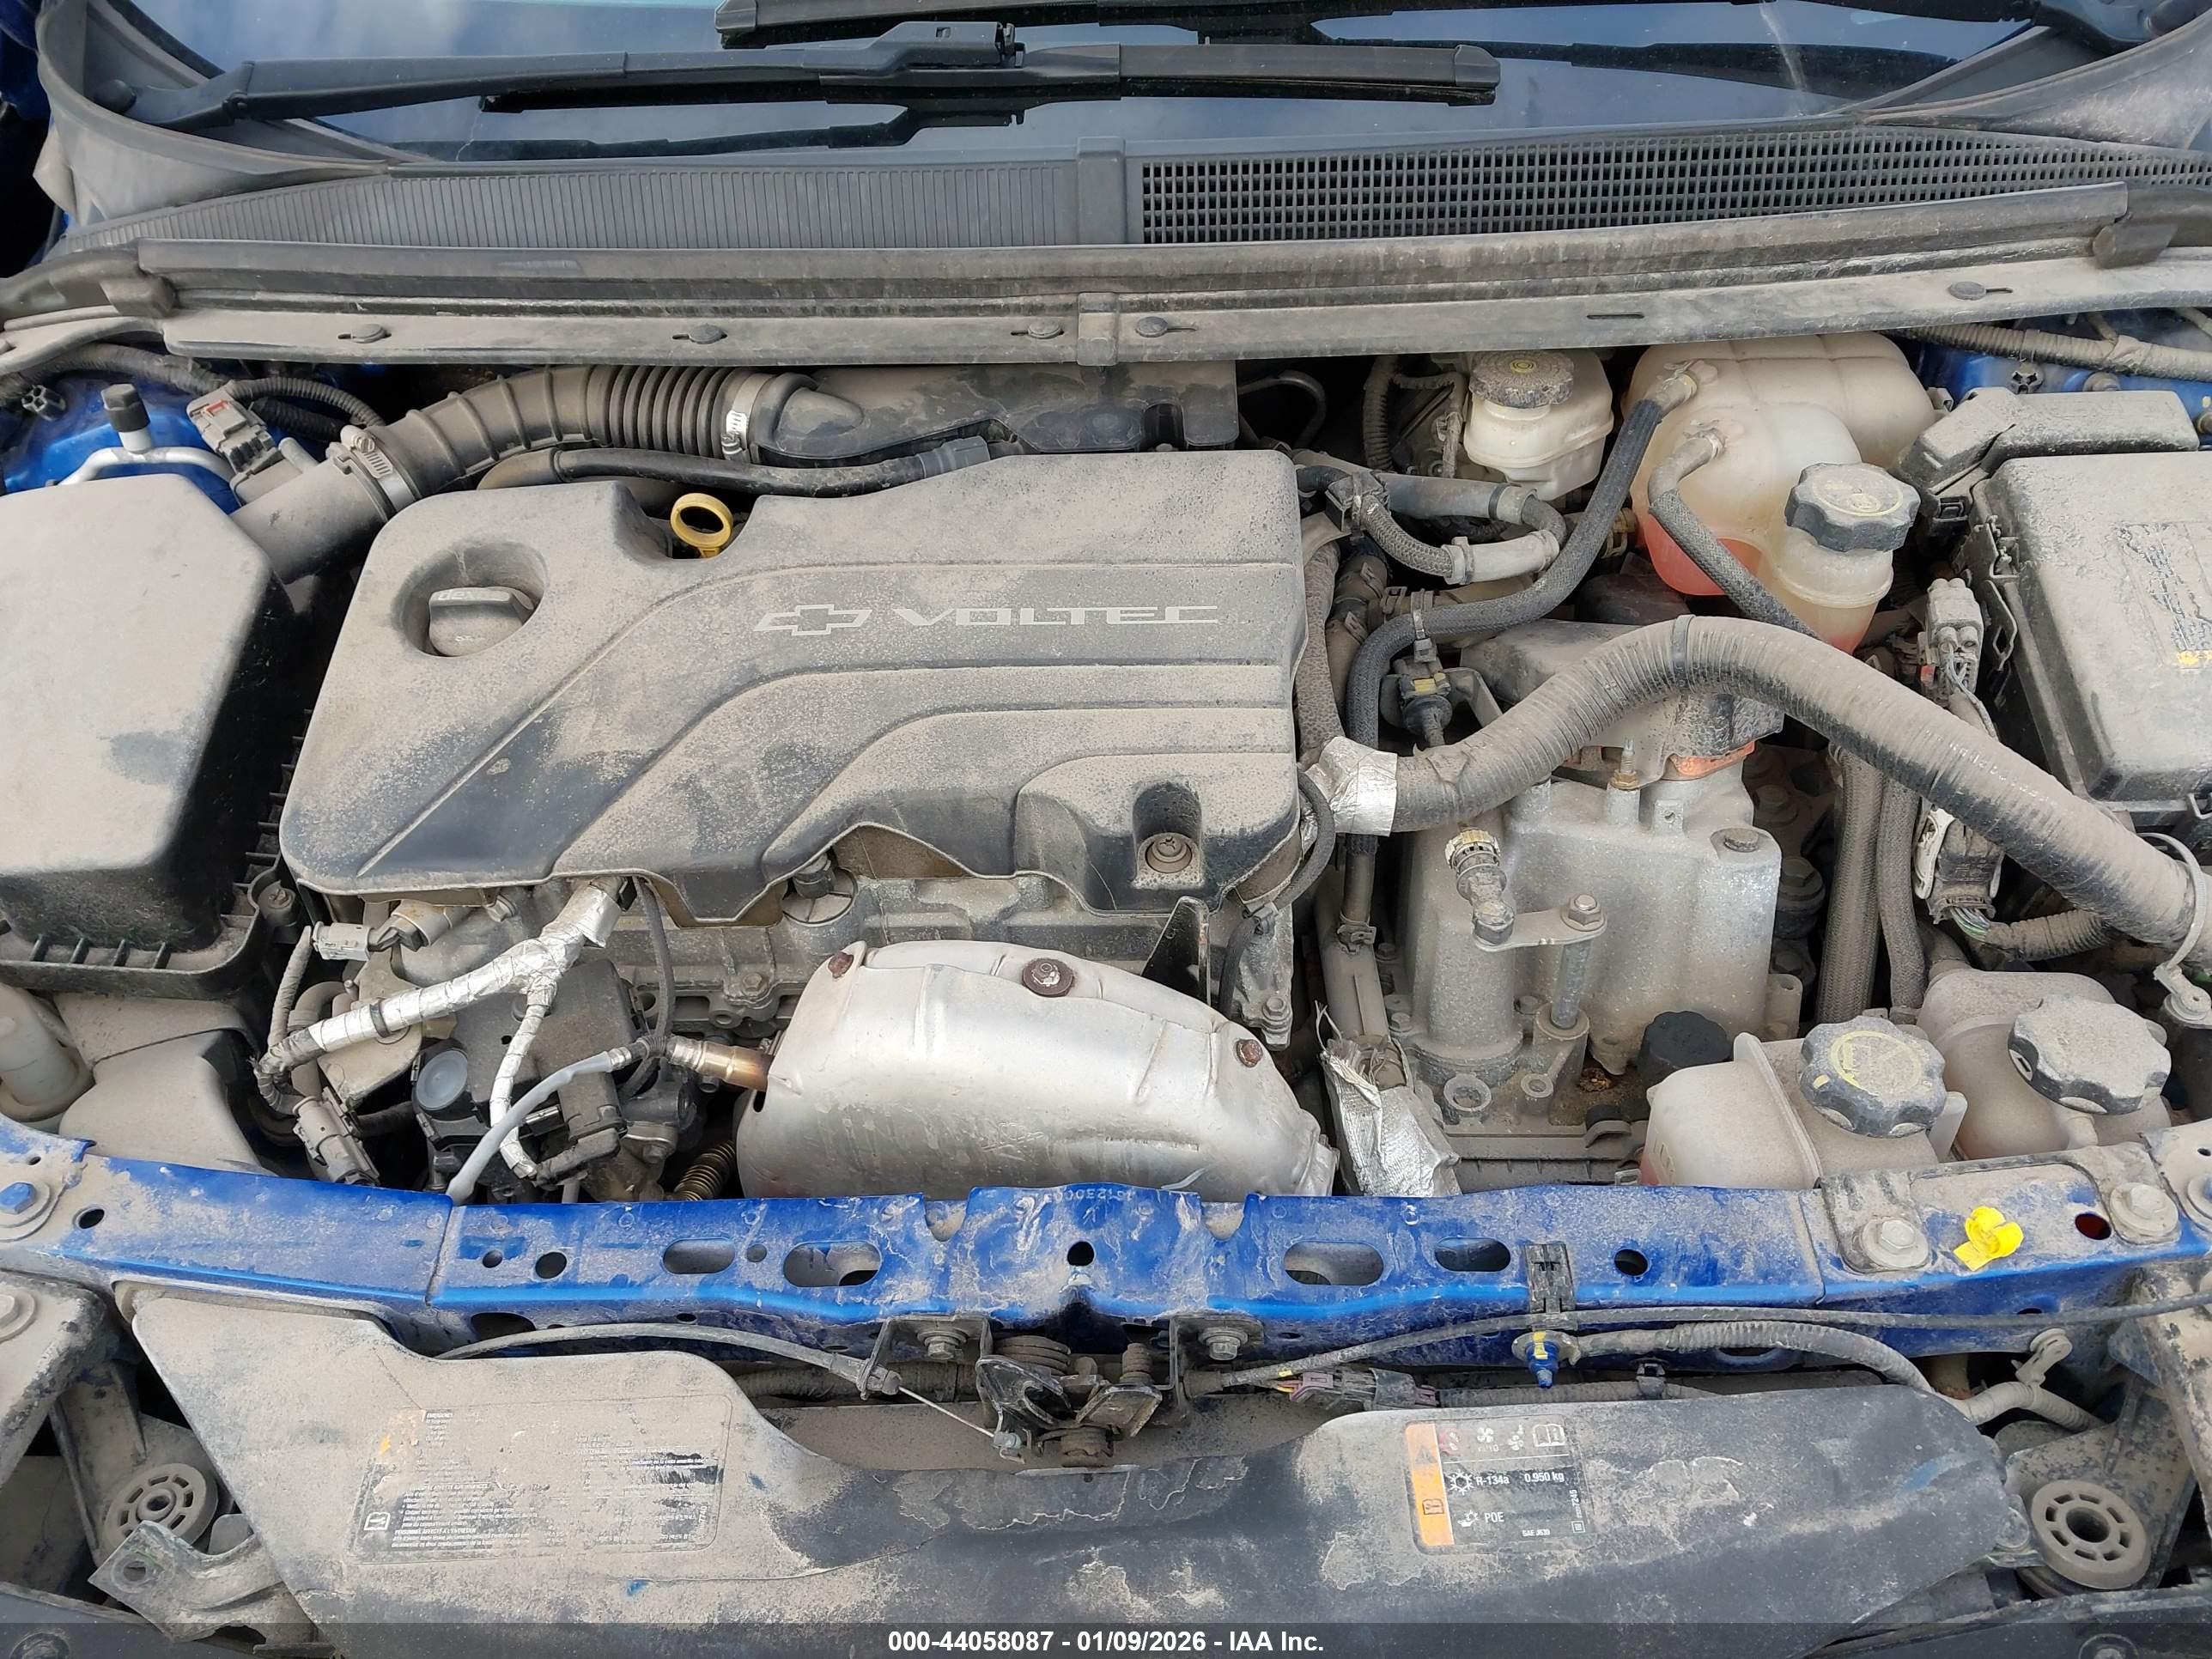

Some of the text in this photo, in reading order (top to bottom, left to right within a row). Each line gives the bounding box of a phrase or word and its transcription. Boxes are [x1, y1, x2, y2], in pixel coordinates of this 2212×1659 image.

[891, 605, 1218, 625] VOLTEC
[1476, 1470, 1565, 1486] R-134a 0.950 kg
[1484, 1511, 1505, 1523] POE
